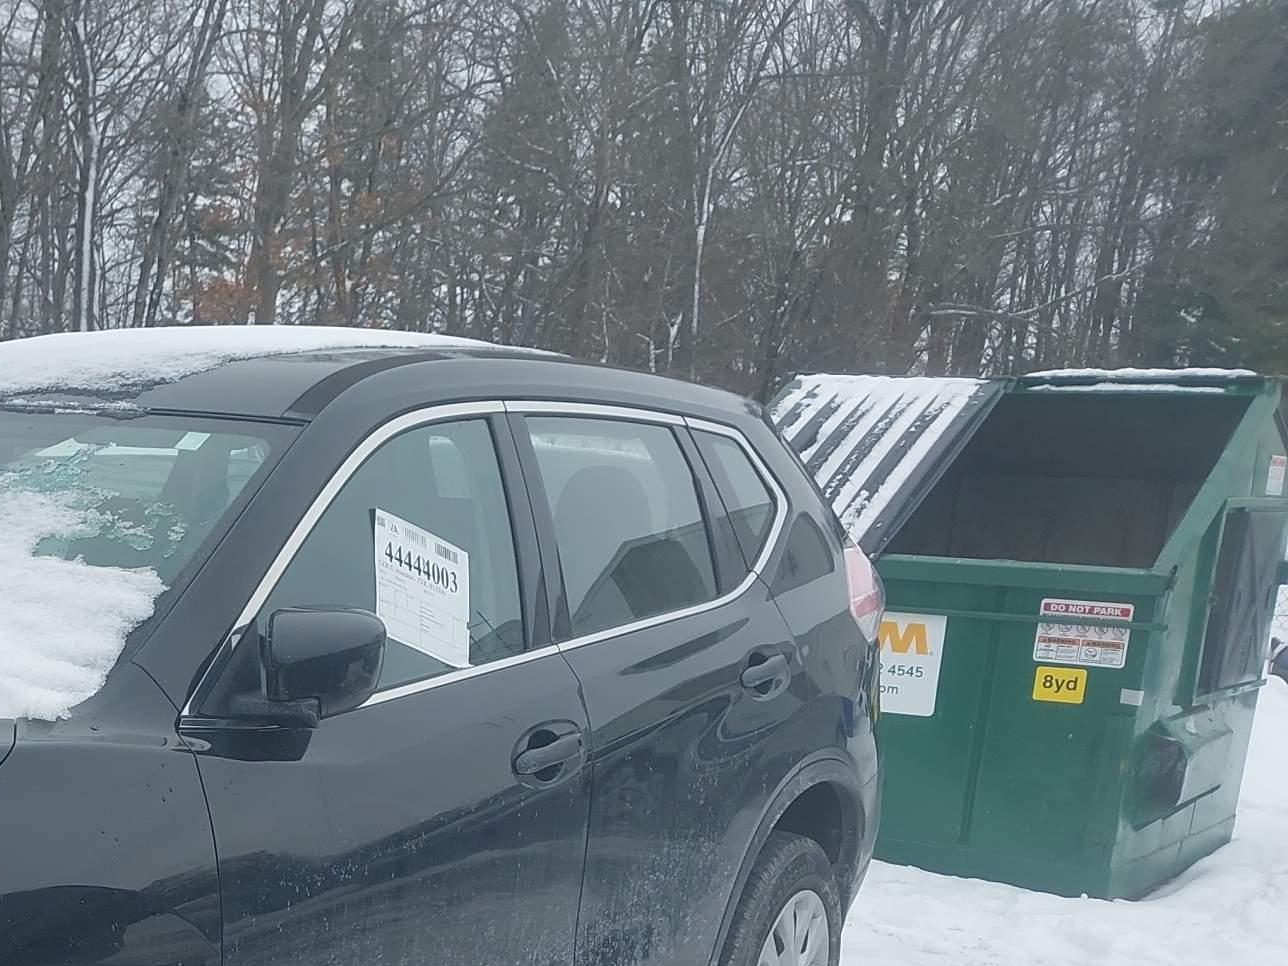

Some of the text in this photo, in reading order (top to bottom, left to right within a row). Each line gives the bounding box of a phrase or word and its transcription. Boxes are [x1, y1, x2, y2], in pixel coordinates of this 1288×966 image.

[384, 541, 458, 594] 44444003
[1050, 603, 1066, 612] DO
[1068, 605, 1090, 614] NOT
[1093, 607, 1123, 617] PARK
[887, 664, 924, 678] 4545
[1042, 674, 1079, 693] 8yd
